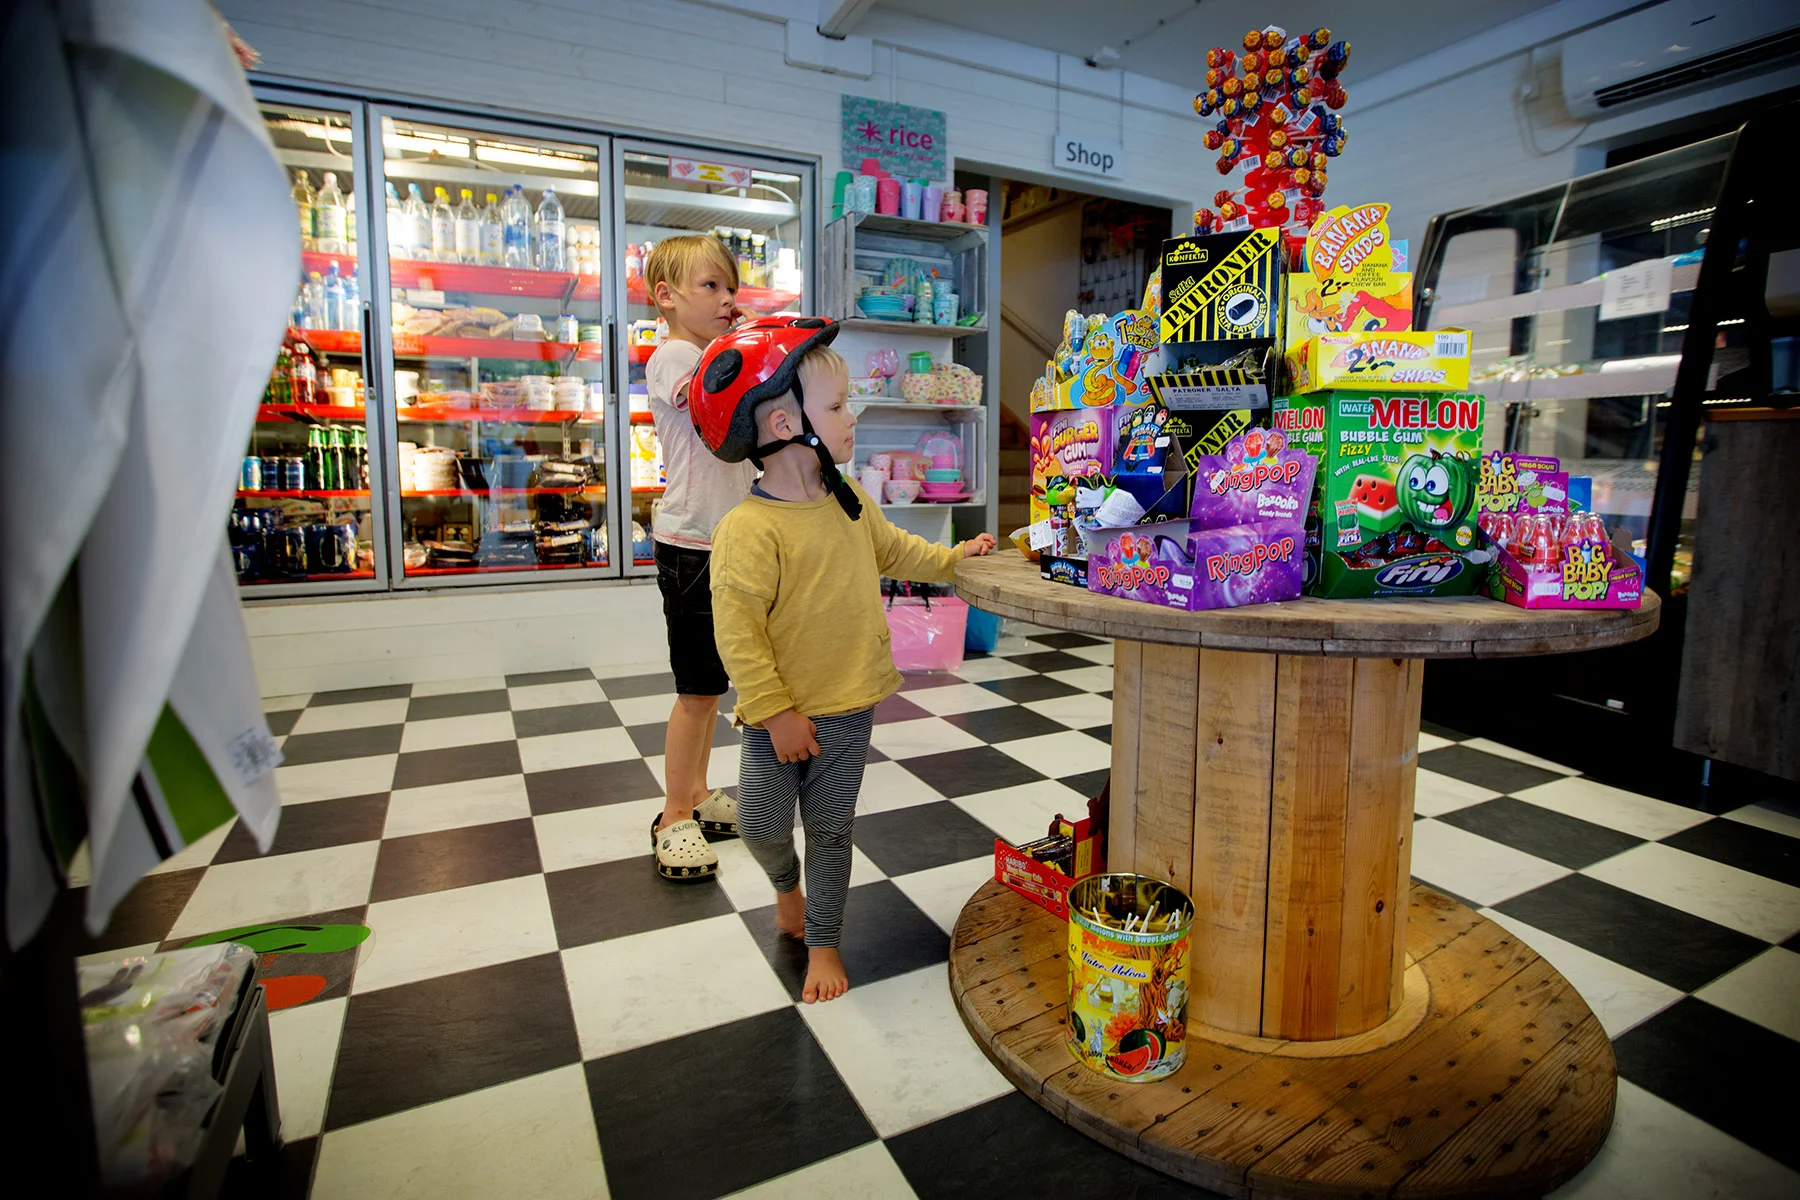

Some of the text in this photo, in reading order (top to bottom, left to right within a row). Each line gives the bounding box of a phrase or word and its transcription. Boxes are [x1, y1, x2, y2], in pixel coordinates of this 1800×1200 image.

[889, 124, 933, 151] rice
[1066, 141, 1114, 173] Shop
[1314, 207, 1381, 270] BANANA
[1169, 252, 1206, 263] KONFEKTA
[1339, 227, 1384, 274] SKIDS
[1164, 232, 1271, 330] PATRONER
[1169, 276, 1196, 304] Salta
[1222, 285, 1262, 301] ORIGINAL
[1217, 302, 1267, 333] SALTA PATRONER
[1345, 339, 1423, 363] BANANA
[1390, 369, 1447, 384] SKIDS
[1273, 406, 1325, 430] MELON
[1341, 404, 1374, 414] WATER
[1369, 397, 1480, 431] MELON
[1053, 421, 1099, 454] BURGER
[1287, 430, 1324, 443] BLE GUM
[1340, 430, 1423, 444] BUBBLE GUM
[1063, 442, 1088, 464] GUM
[1339, 443, 1373, 457] Fizzy
[1334, 464, 1350, 477] WITH
[1478, 473, 1519, 496] BABY
[1257, 493, 1299, 510] Bazooka
[1477, 493, 1520, 512] POP!
[1568, 540, 1606, 564] BIG
[1382, 557, 1458, 585] Fini
[1563, 561, 1613, 584] BABY
[1562, 582, 1609, 600] POP!
[1090, 923, 1115, 939] Melons
[1117, 932, 1134, 943] with
[1135, 934, 1159, 944] Sweet
[1082, 950, 1107, 970] Water
[1106, 964, 1148, 979] Melons
